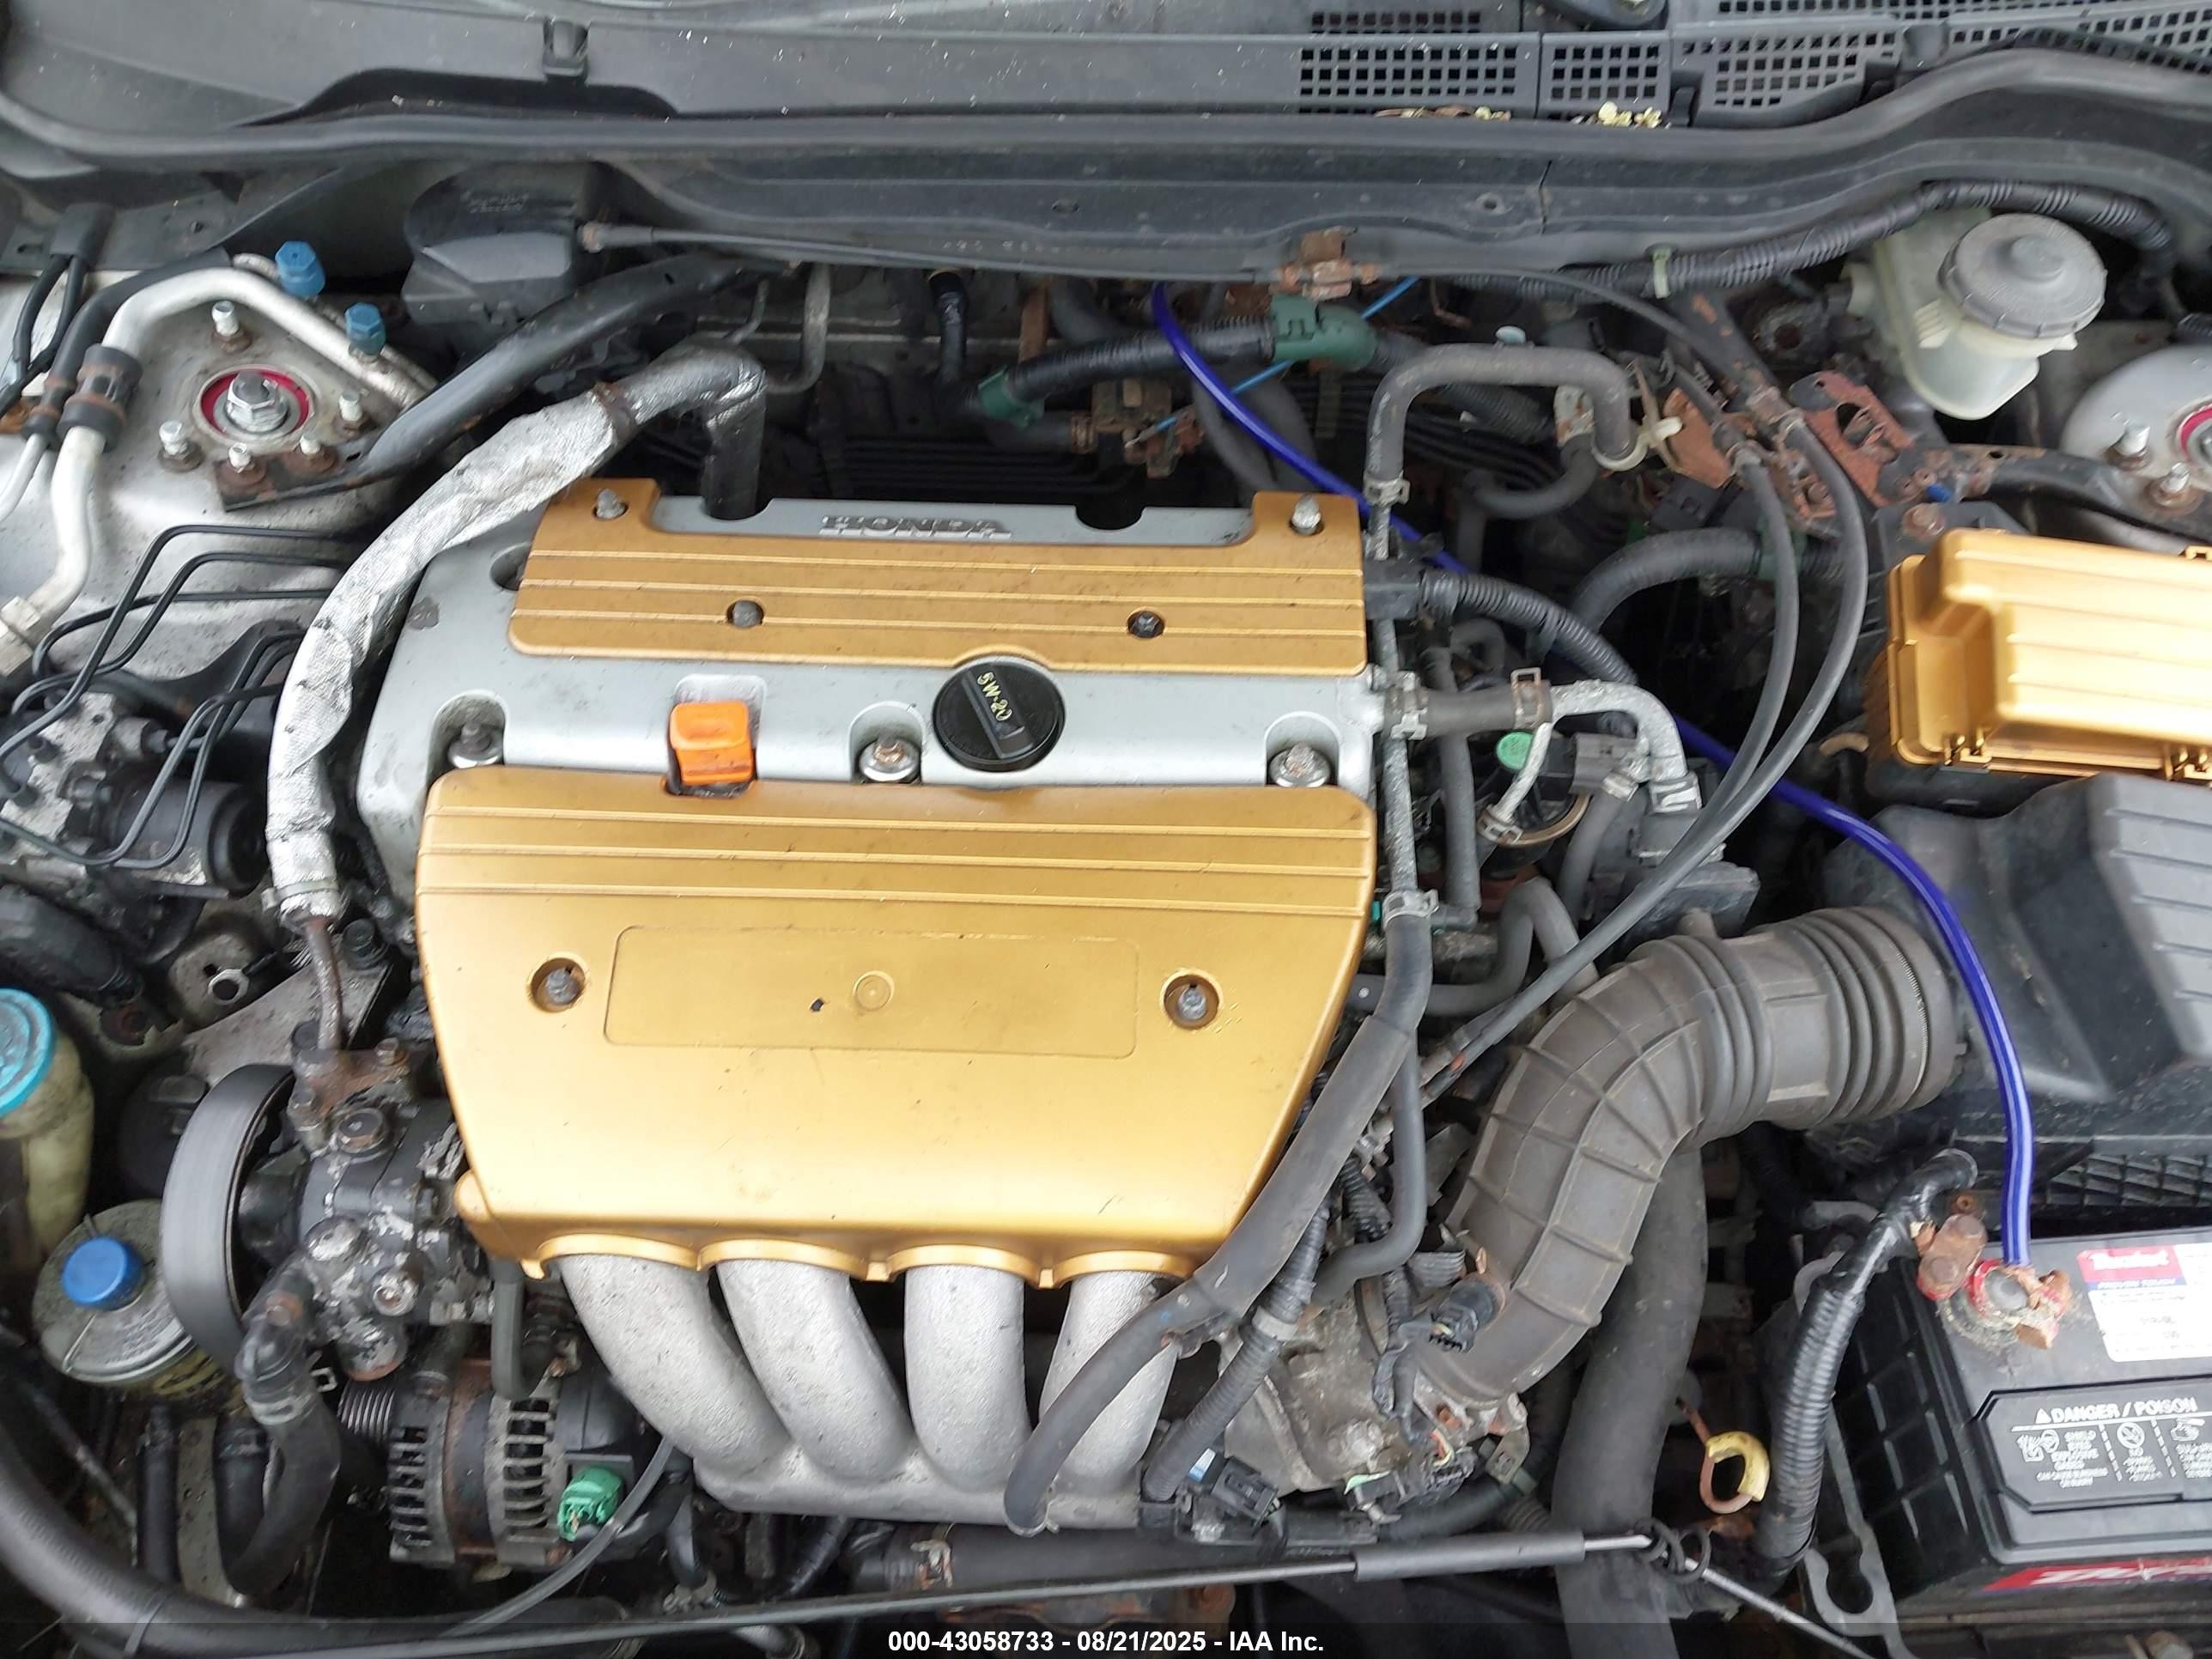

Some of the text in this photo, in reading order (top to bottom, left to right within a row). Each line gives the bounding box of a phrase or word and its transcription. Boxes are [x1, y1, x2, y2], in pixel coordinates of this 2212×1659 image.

[818, 515, 1012, 539] HONDA
[977, 672, 1012, 721] 5W-20
[2051, 1403, 2121, 1423] DANGER
[2133, 1397, 2199, 1416] POISON
